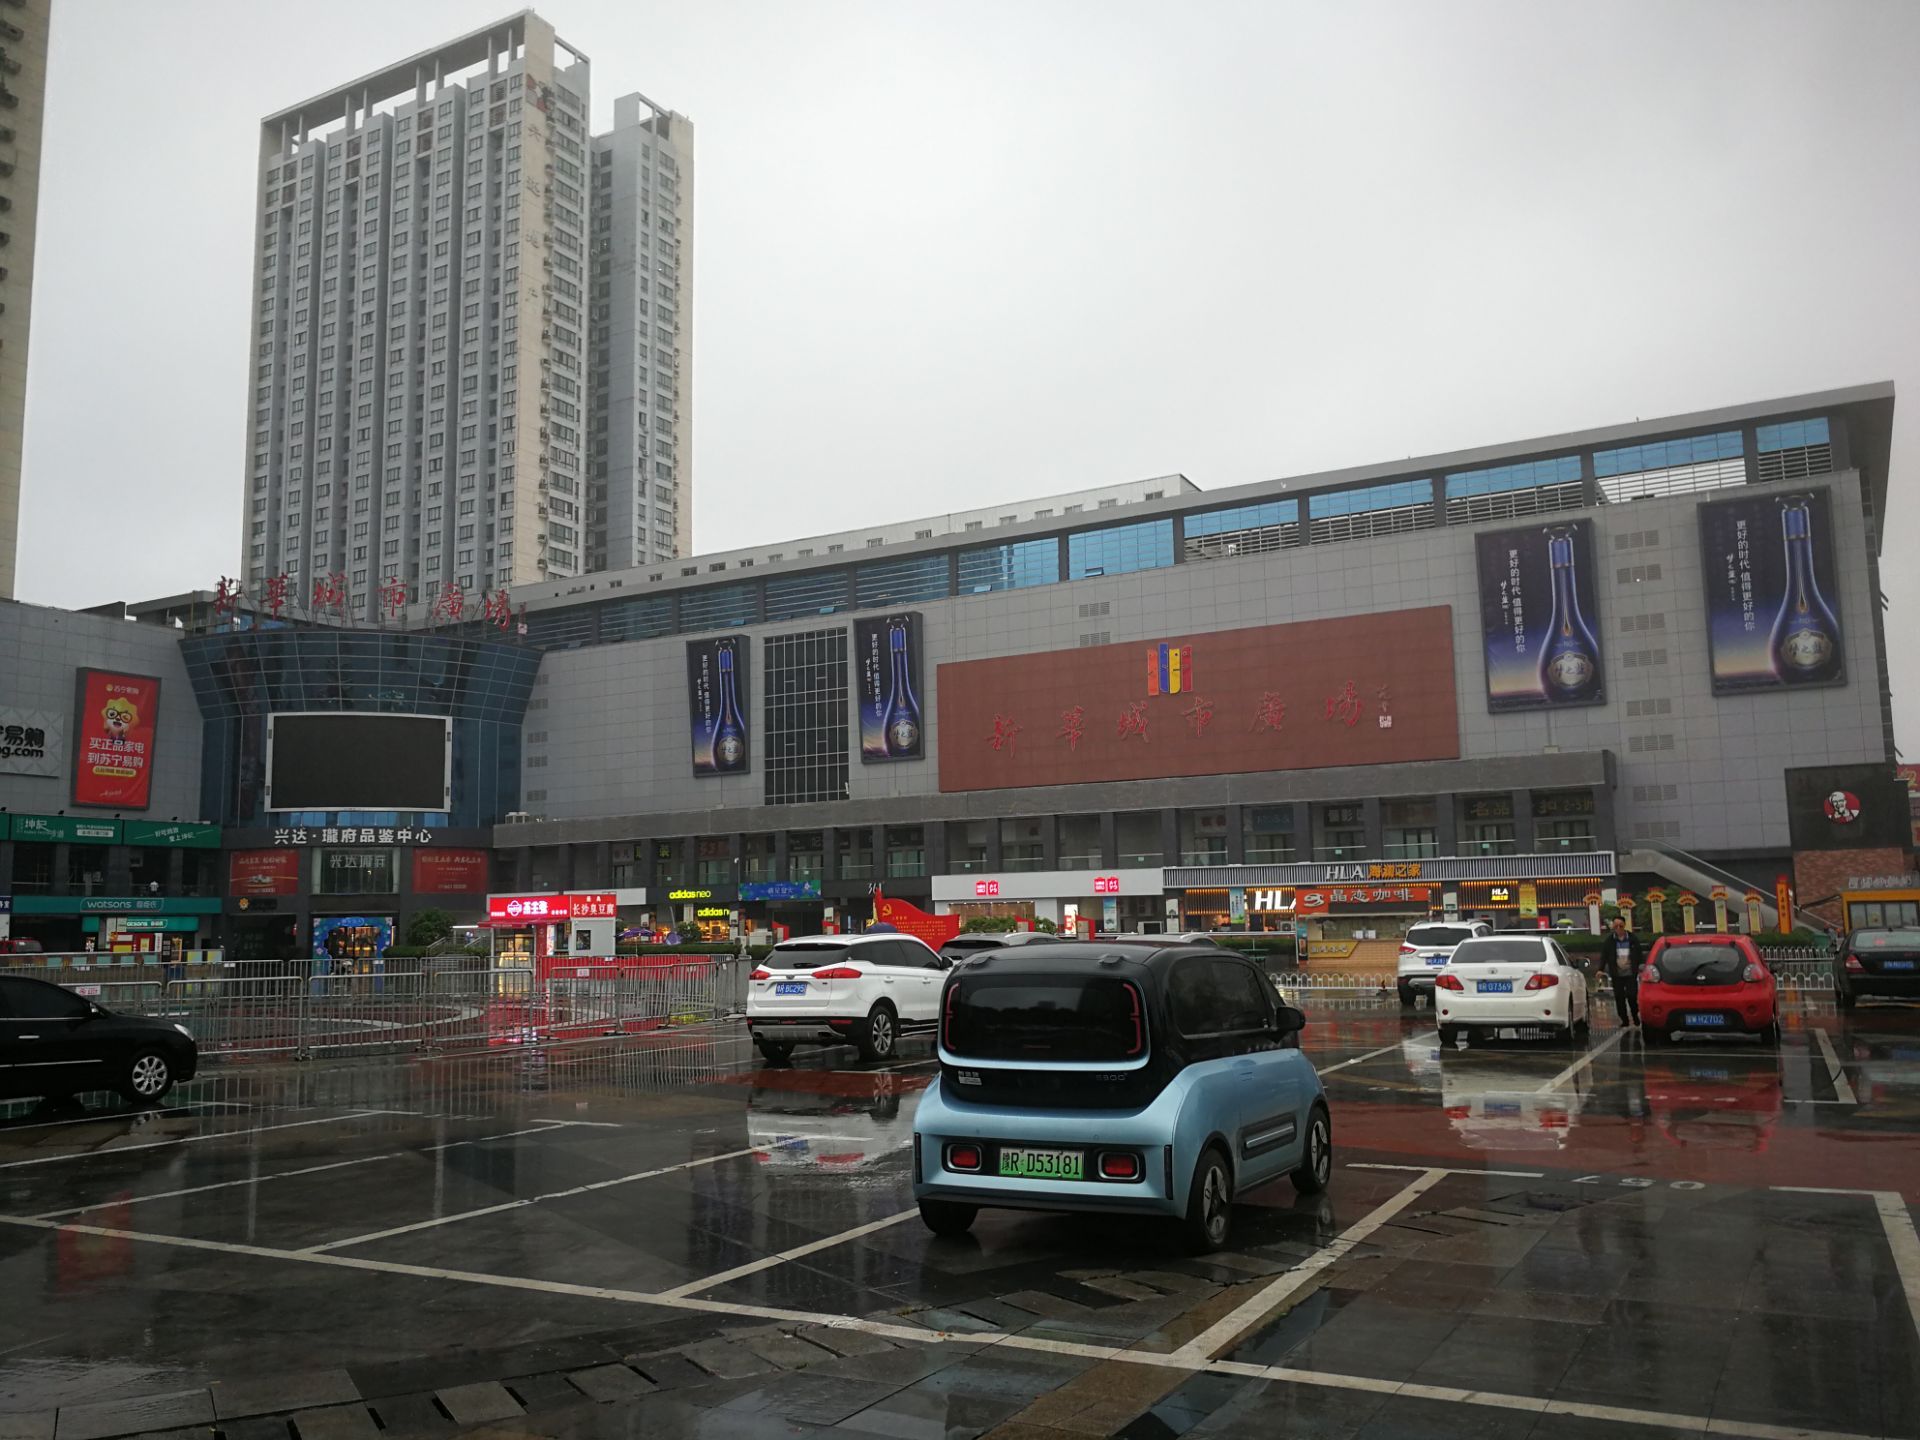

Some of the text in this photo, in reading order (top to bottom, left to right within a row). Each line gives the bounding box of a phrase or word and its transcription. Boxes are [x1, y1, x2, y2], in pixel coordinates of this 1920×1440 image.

[1737, 520, 1755, 631] 更好的时代 值得更好的你
[1509, 549, 1526, 652] 更好的时代 值得更好的你
[0, 725, 45, 748] 易购
[89, 737, 145, 754] 买正品家电
[87, 752, 144, 768] 到苏宁易购
[1326, 864, 1421, 880] HLA 海澜之家
[669, 890, 712, 900] adidas neo
[1330, 888, 1415, 903] 晶恋咖啡
[1492, 888, 1508, 896] HLA
[87, 900, 132, 909] watsons
[572, 903, 615, 917] 长沙臭豆腐
[697, 907, 723, 916] adidas
